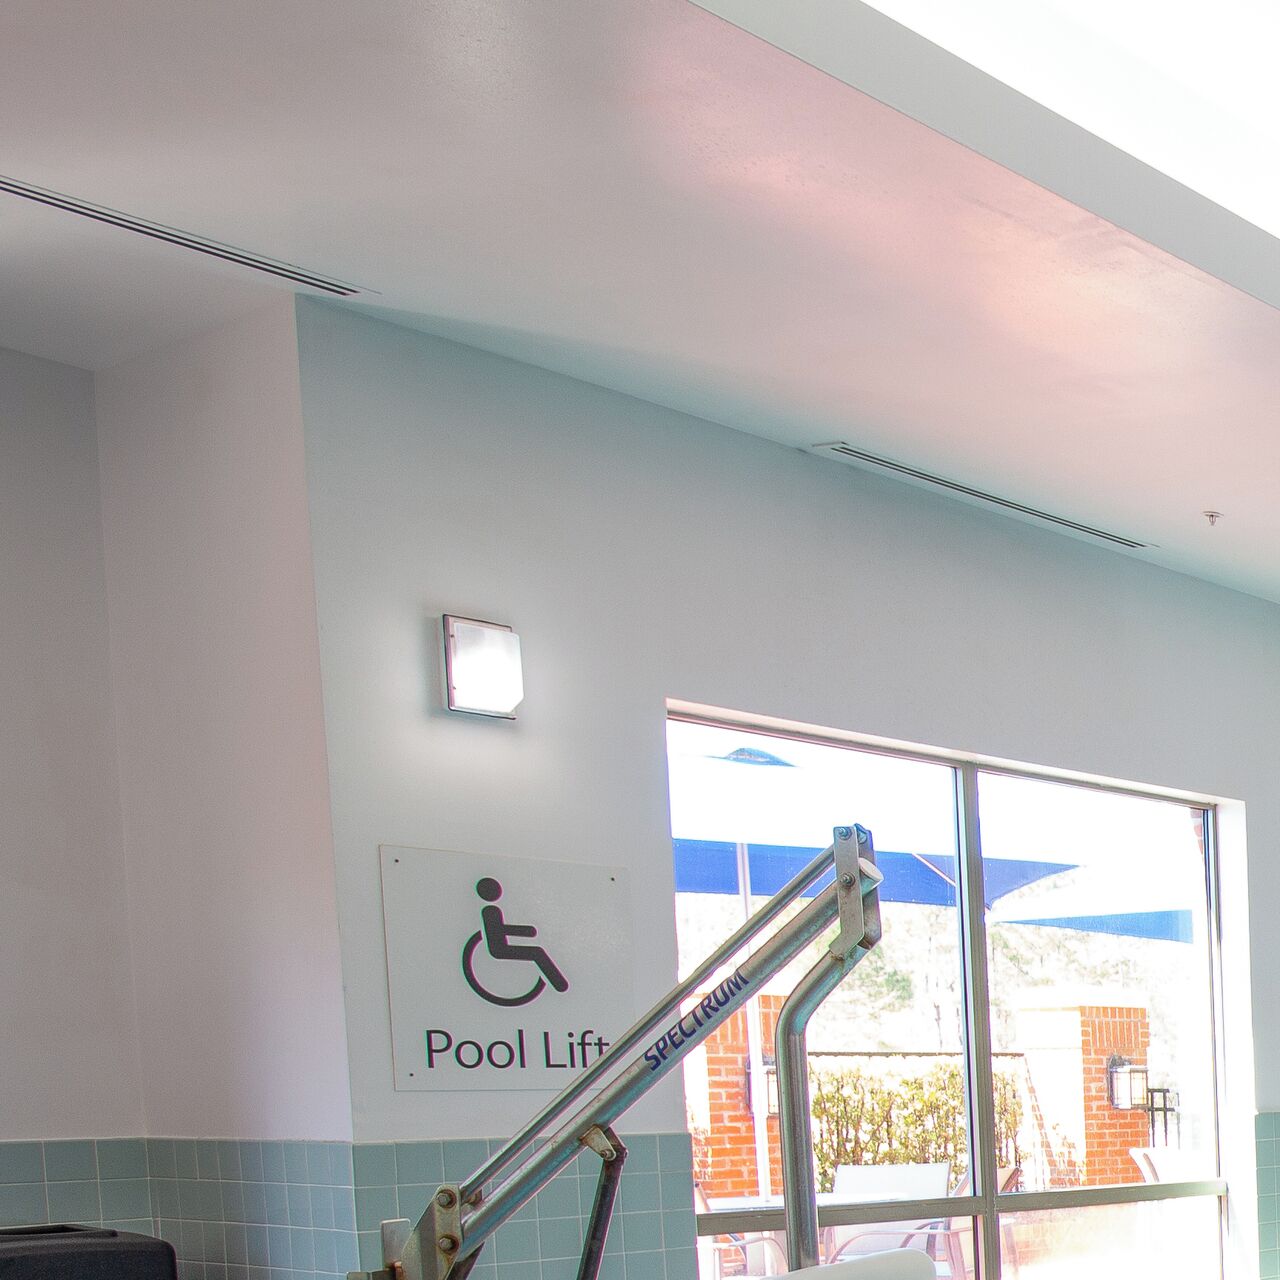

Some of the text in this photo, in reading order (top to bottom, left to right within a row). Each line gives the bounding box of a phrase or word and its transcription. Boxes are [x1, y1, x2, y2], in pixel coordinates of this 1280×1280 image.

[425, 1029, 610, 1069] Pool Lift
[644, 970, 750, 1071] SPECTRUM
